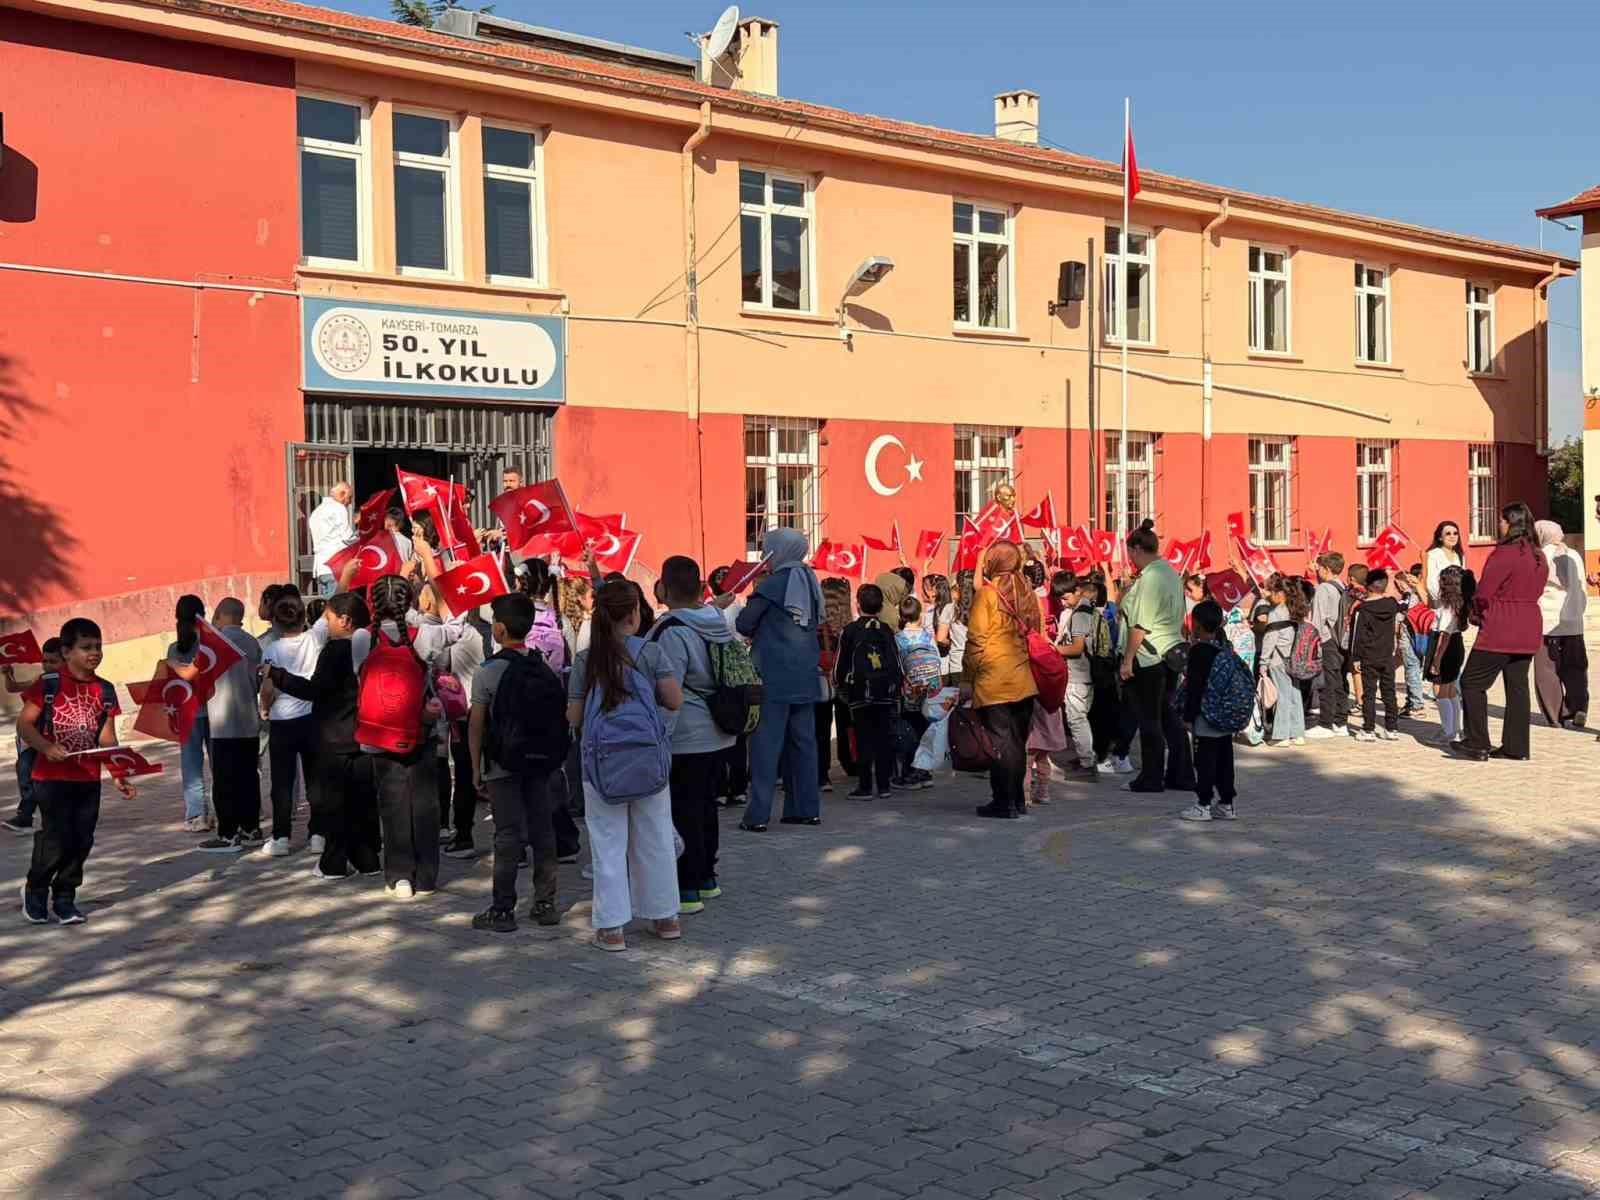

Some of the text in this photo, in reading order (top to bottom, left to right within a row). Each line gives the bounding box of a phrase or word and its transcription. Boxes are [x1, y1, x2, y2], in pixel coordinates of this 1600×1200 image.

[381, 318, 479, 336] KAYSERİ-TOMARZA
[382, 333, 429, 354] 50.
[439, 337, 488, 358] YIL
[383, 356, 538, 386] İLKOKULU
